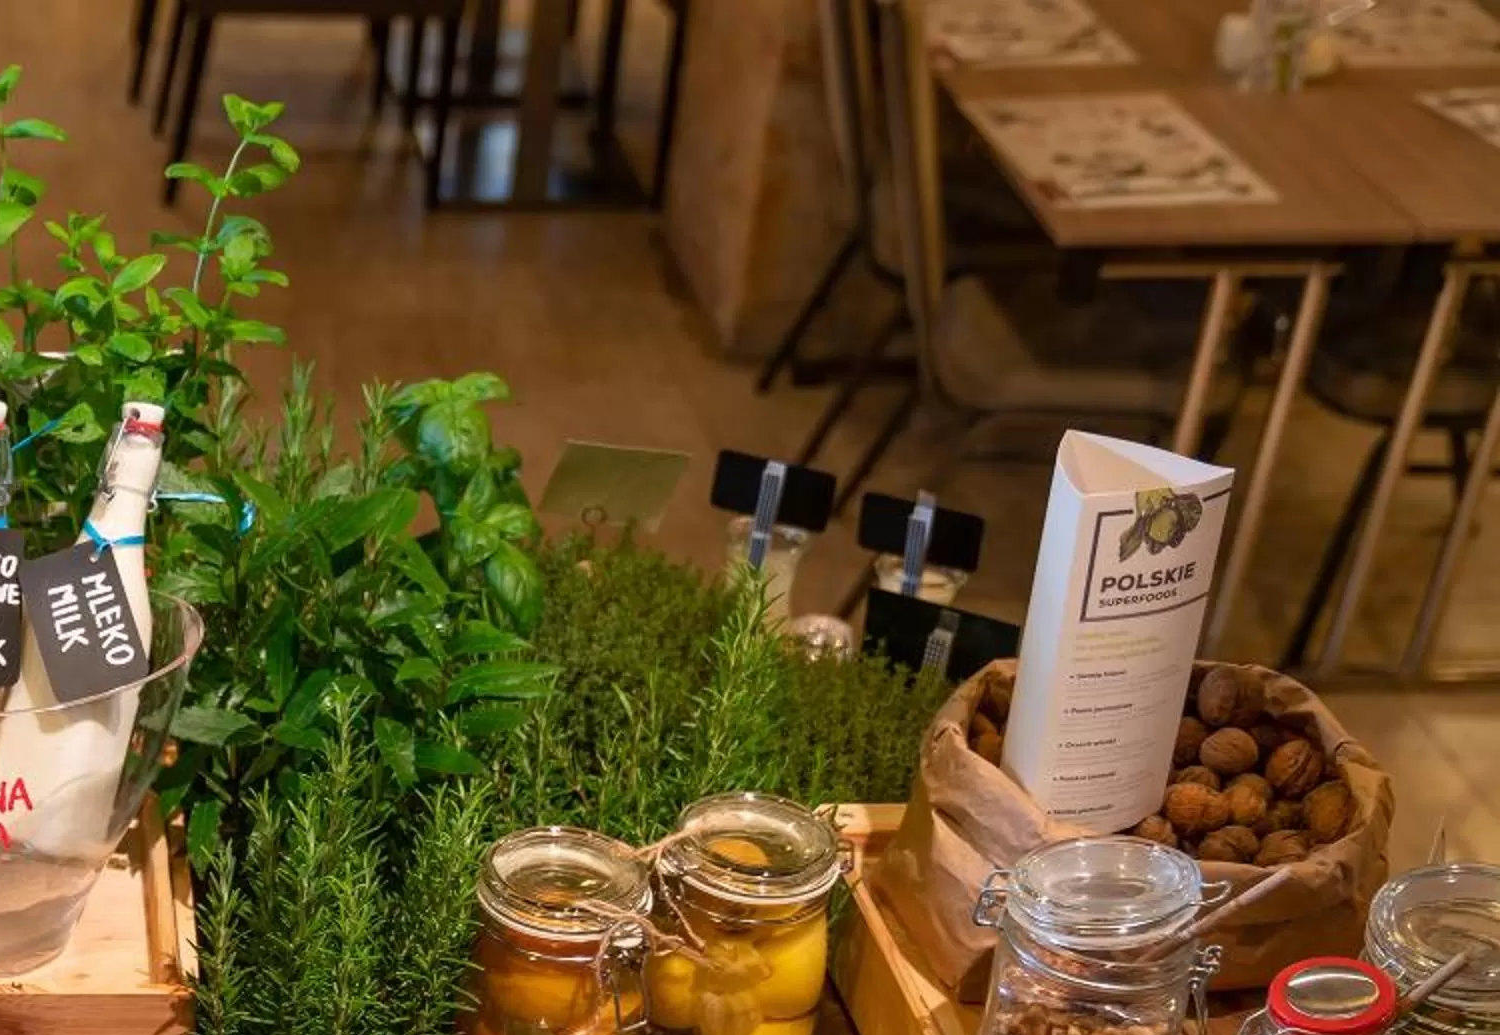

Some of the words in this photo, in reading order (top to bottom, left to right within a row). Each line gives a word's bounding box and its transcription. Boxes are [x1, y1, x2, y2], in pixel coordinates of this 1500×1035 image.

[1100, 561, 1197, 592] POLSKIE
[47, 583, 90, 653] MILK
[82, 572, 135, 665] MLEKO
